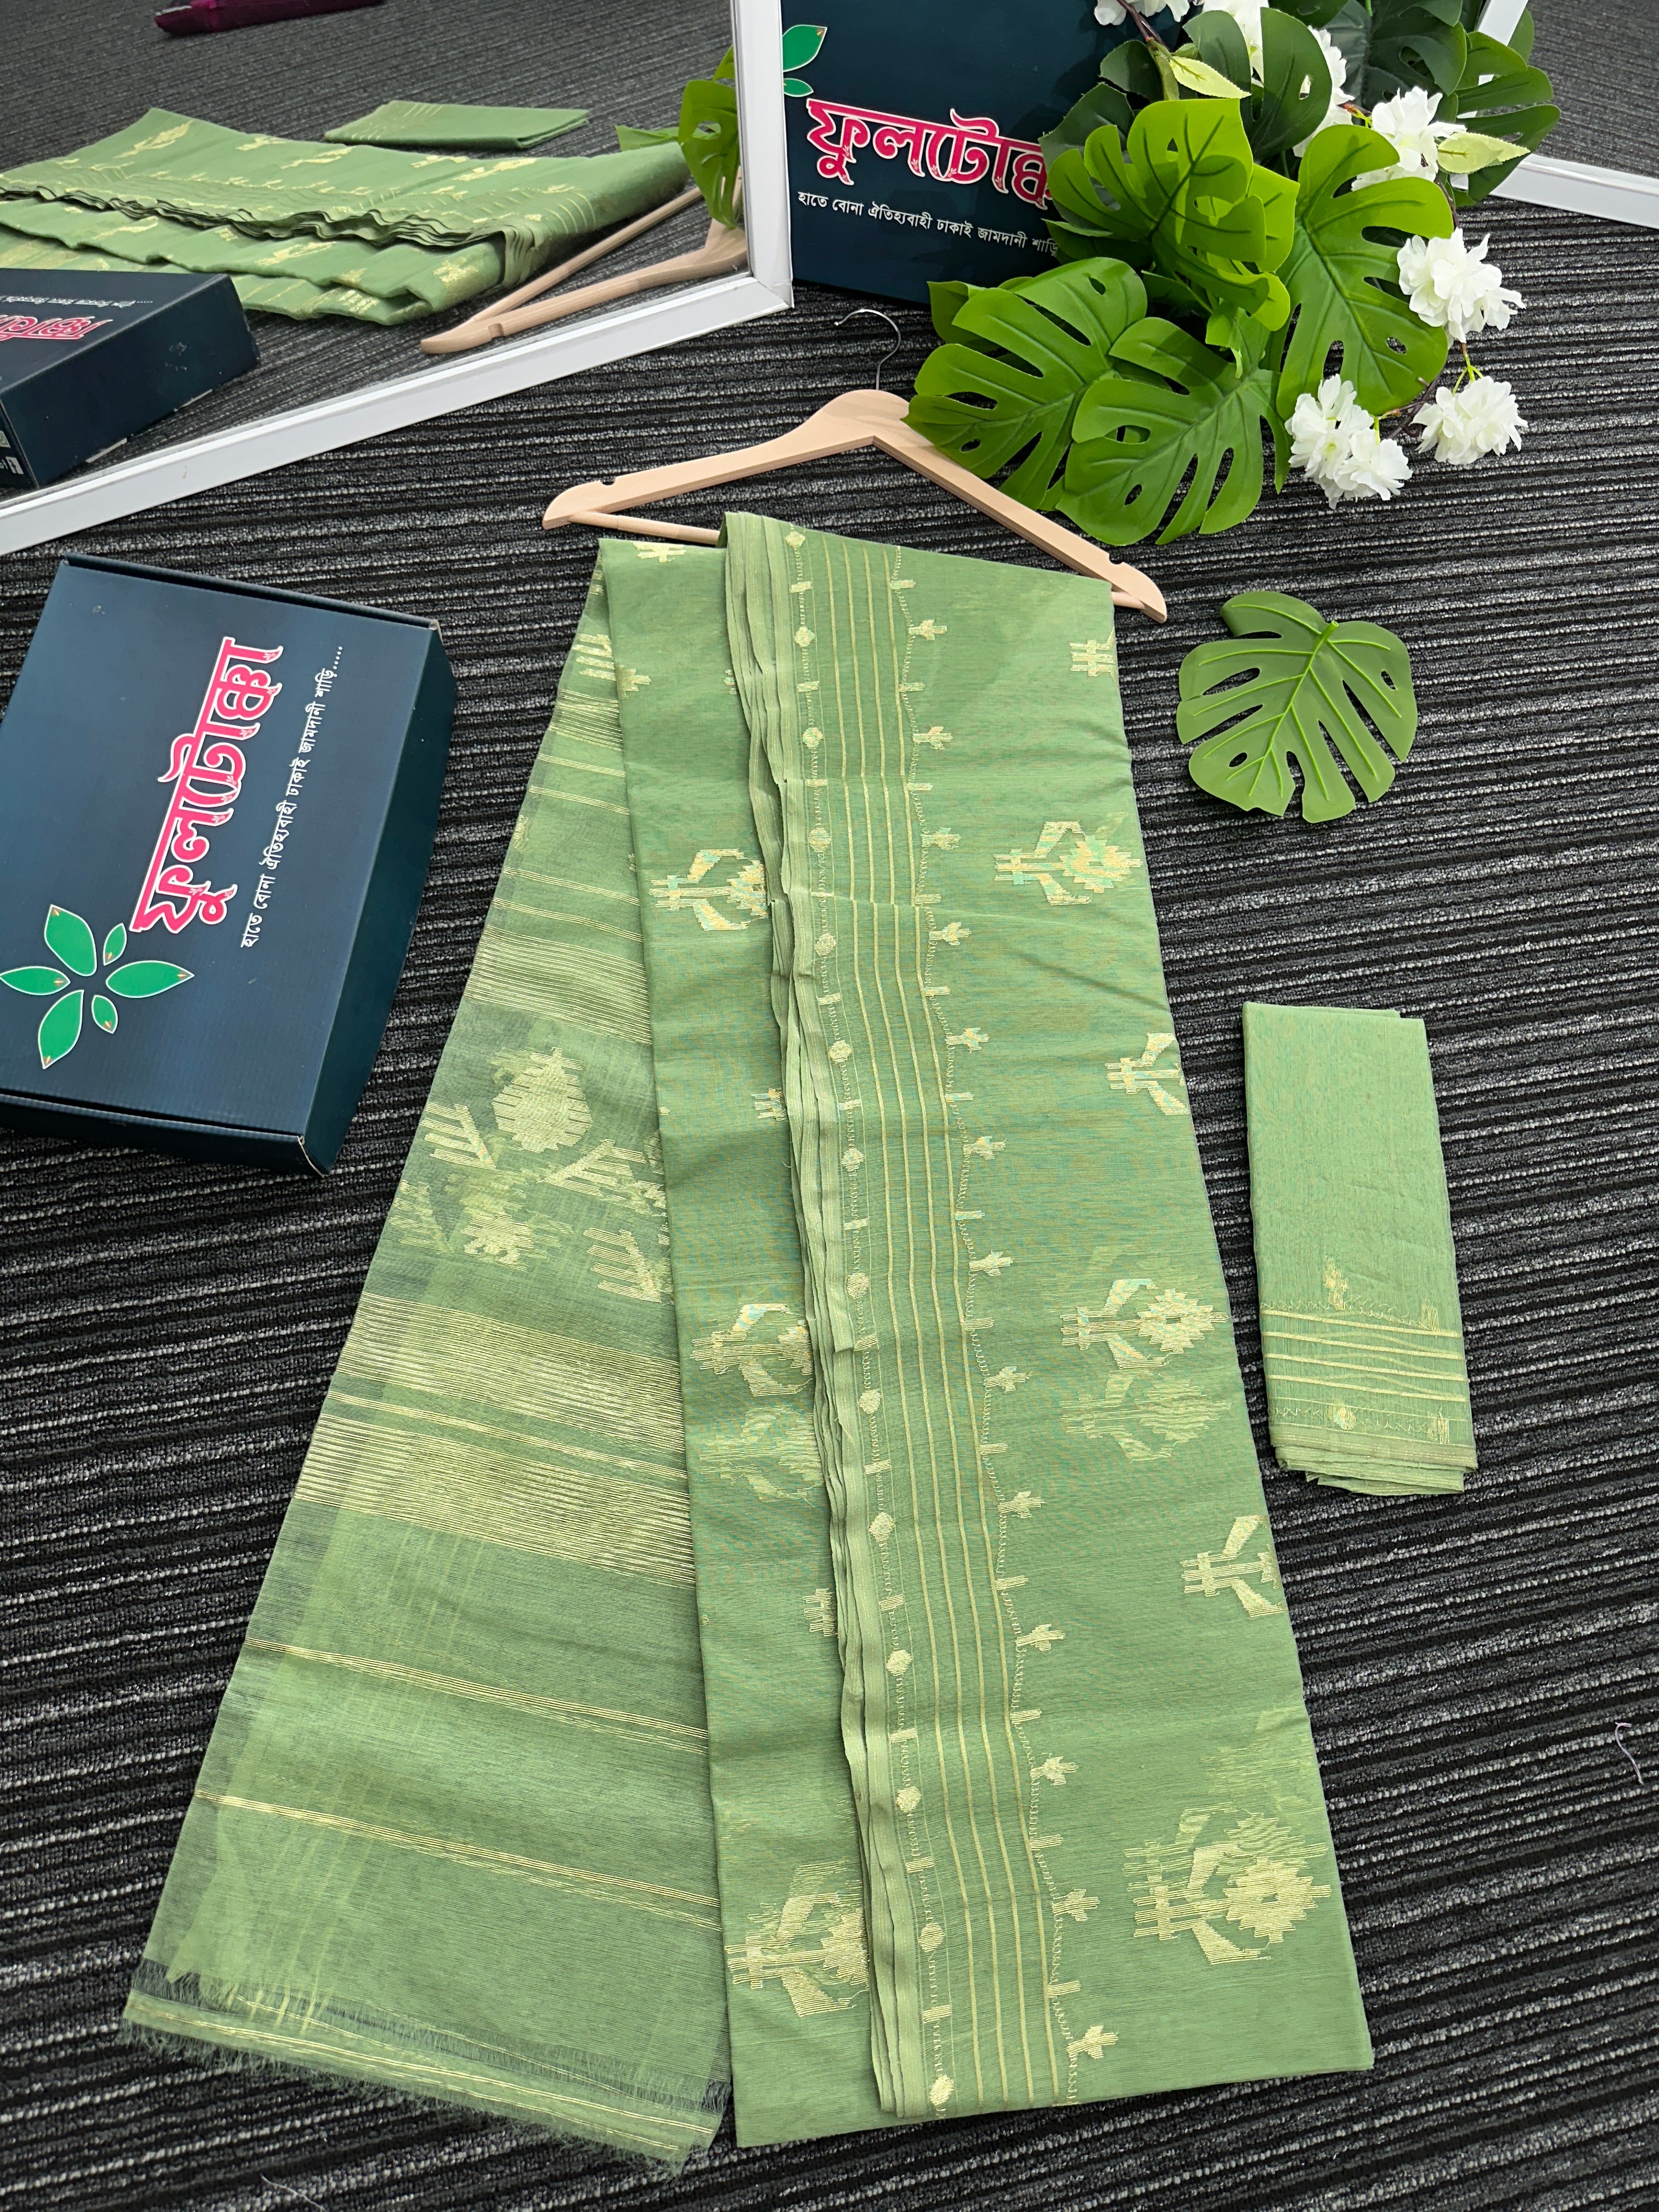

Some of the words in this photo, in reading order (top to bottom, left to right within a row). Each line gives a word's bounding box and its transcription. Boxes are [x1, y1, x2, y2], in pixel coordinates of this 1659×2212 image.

[797, 191, 829, 207] হাতে
[832, 199, 865, 216] বোনা
[868, 201, 933, 230] ঐতিহ্যবাহী
[936, 219, 973, 238] ঢাকাই
[978, 226, 1028, 249] জামদানী
[298, 701, 326, 754] জামদানী
[285, 757, 311, 797] ঢাকাই
[258, 799, 298, 870] ঐতিহ্যবাহী
[253, 873, 276, 909] বোনা
[240, 912, 263, 948] হাতে
